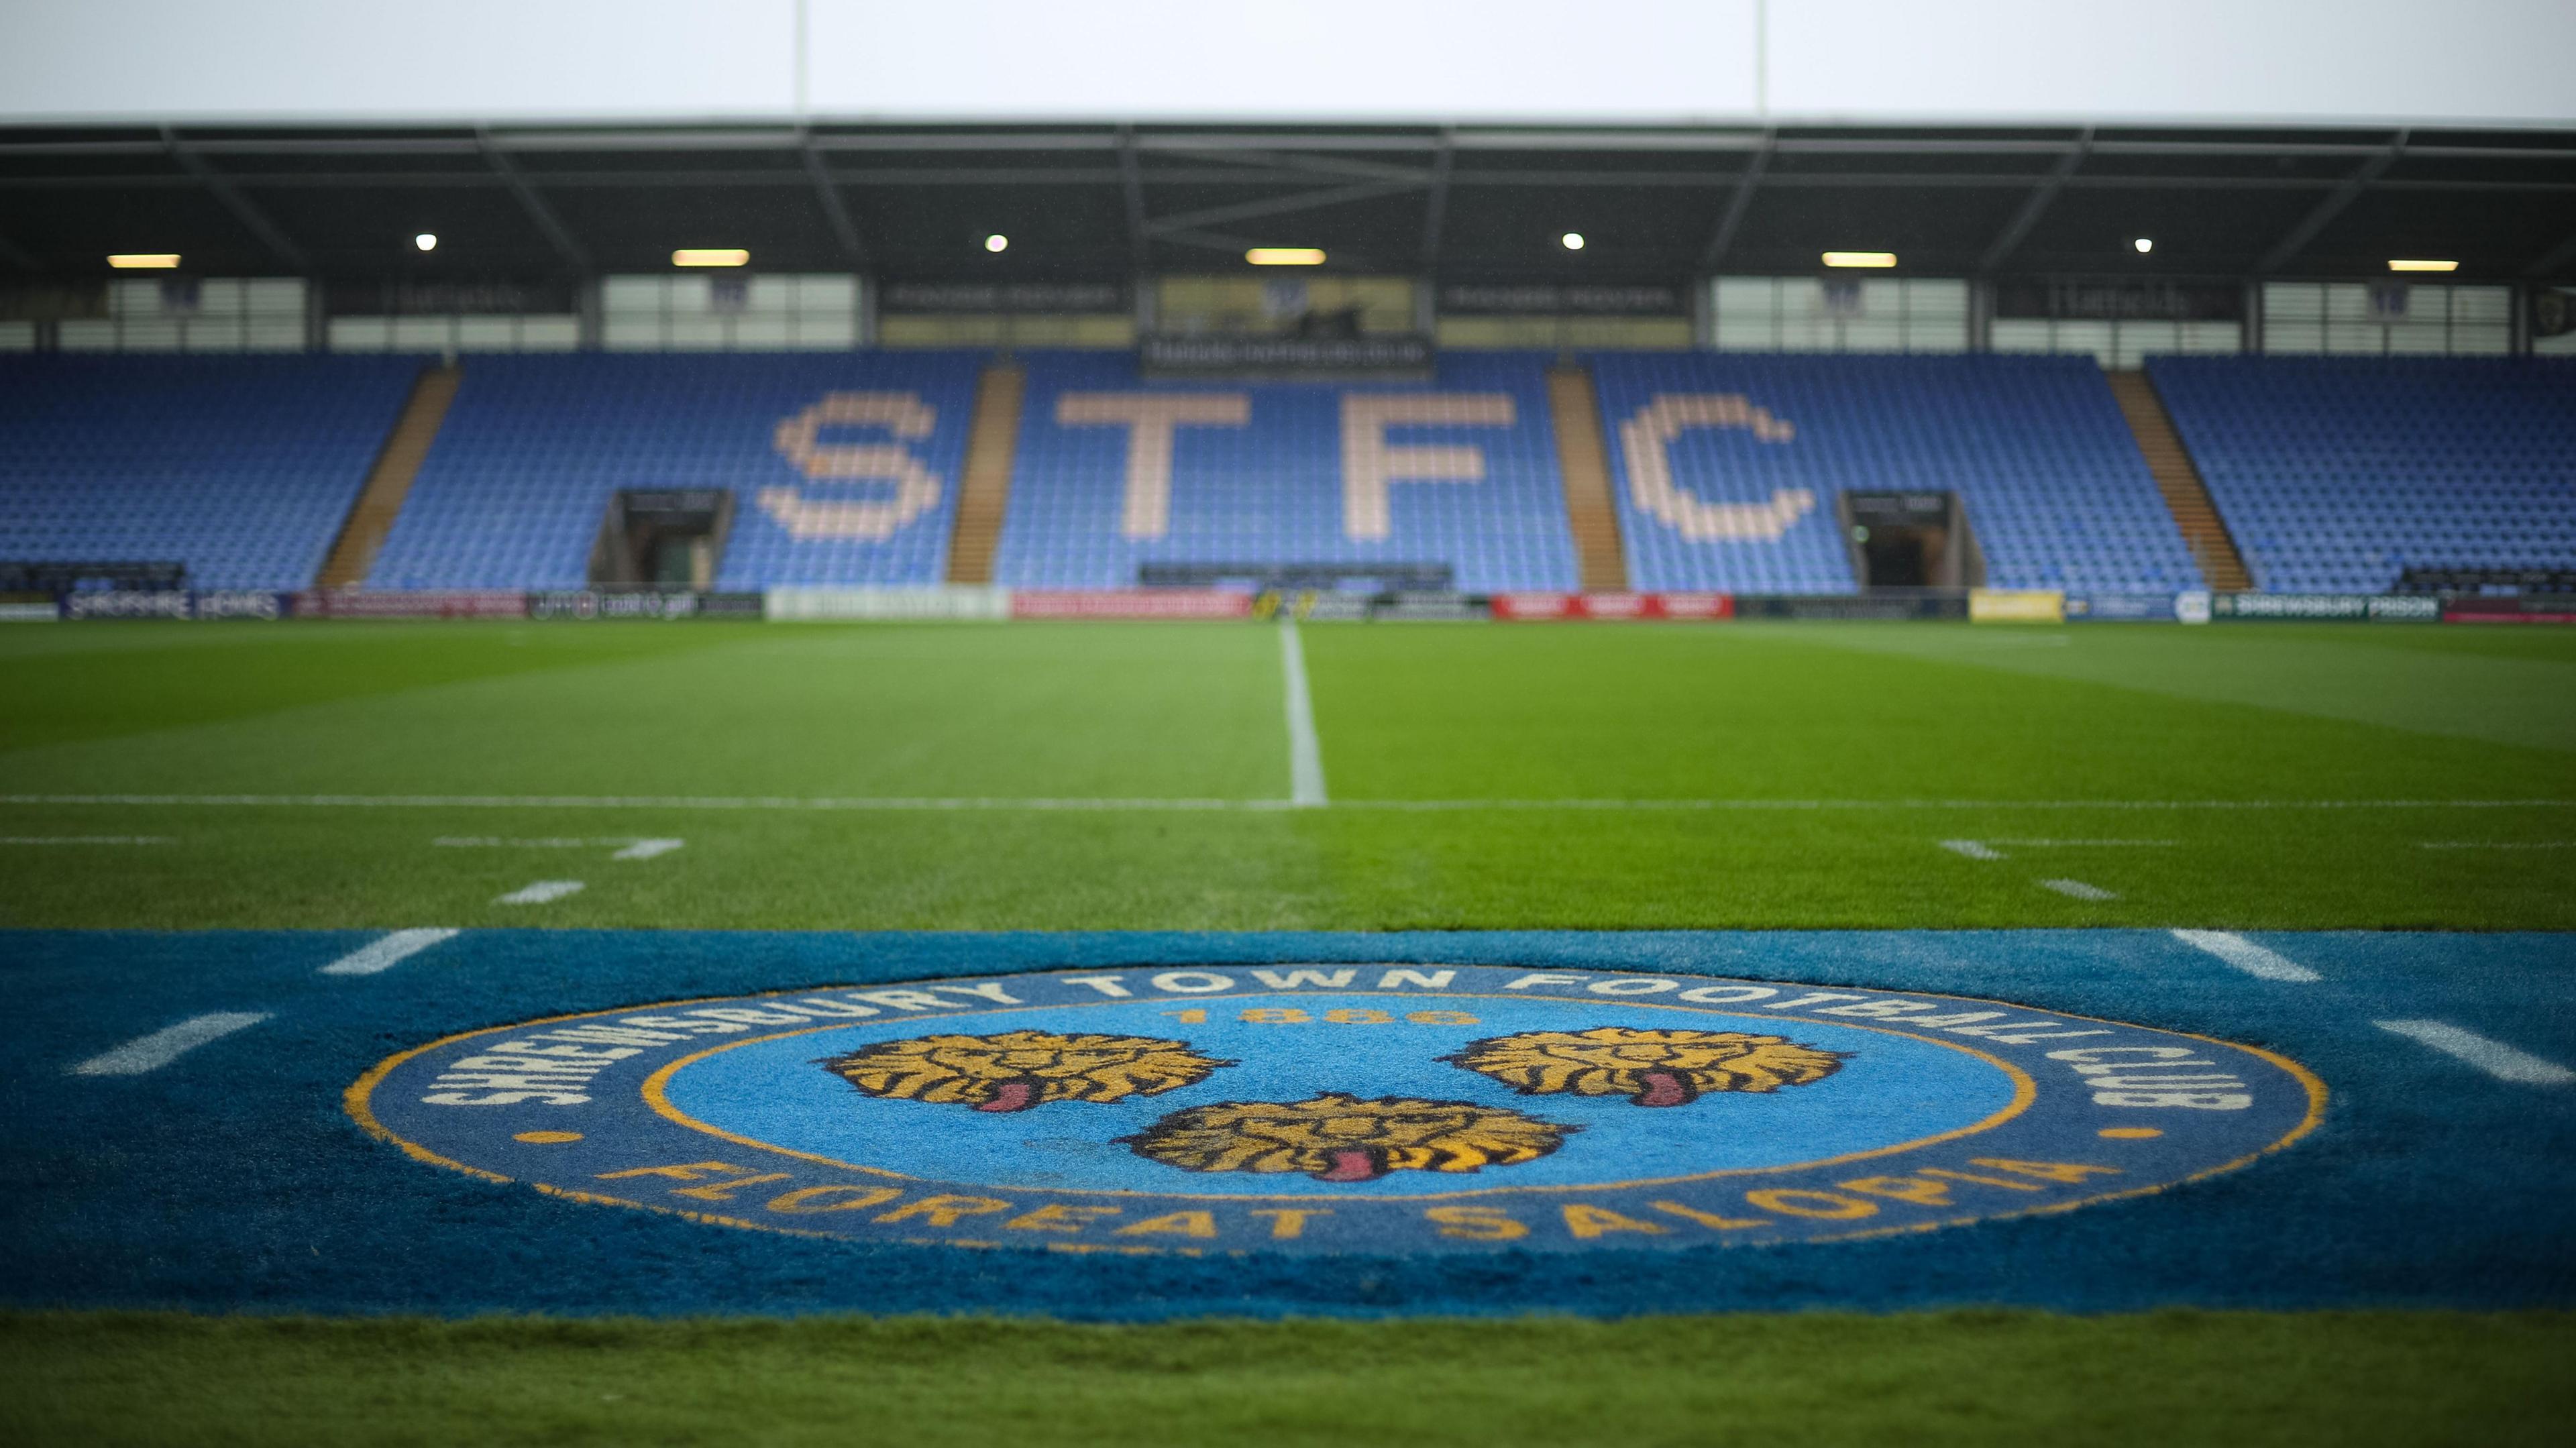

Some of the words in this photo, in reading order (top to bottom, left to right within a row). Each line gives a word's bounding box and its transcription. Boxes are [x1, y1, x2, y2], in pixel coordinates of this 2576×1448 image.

[2236, 594, 2366, 618] SHREWSBURY
[2369, 595, 2438, 618] PRISON
[421, 983, 1023, 1105] SHREWSBURY
[1061, 969, 1456, 997] TOWN
[1503, 973, 2114, 1044] FOOTBALL
[2046, 1046, 2253, 1110] CLUB
[1160, 1007, 1481, 1025] 1886
[594, 1160, 1334, 1239] FLOREAT
[1424, 1158, 2124, 1240] SALOPIA
